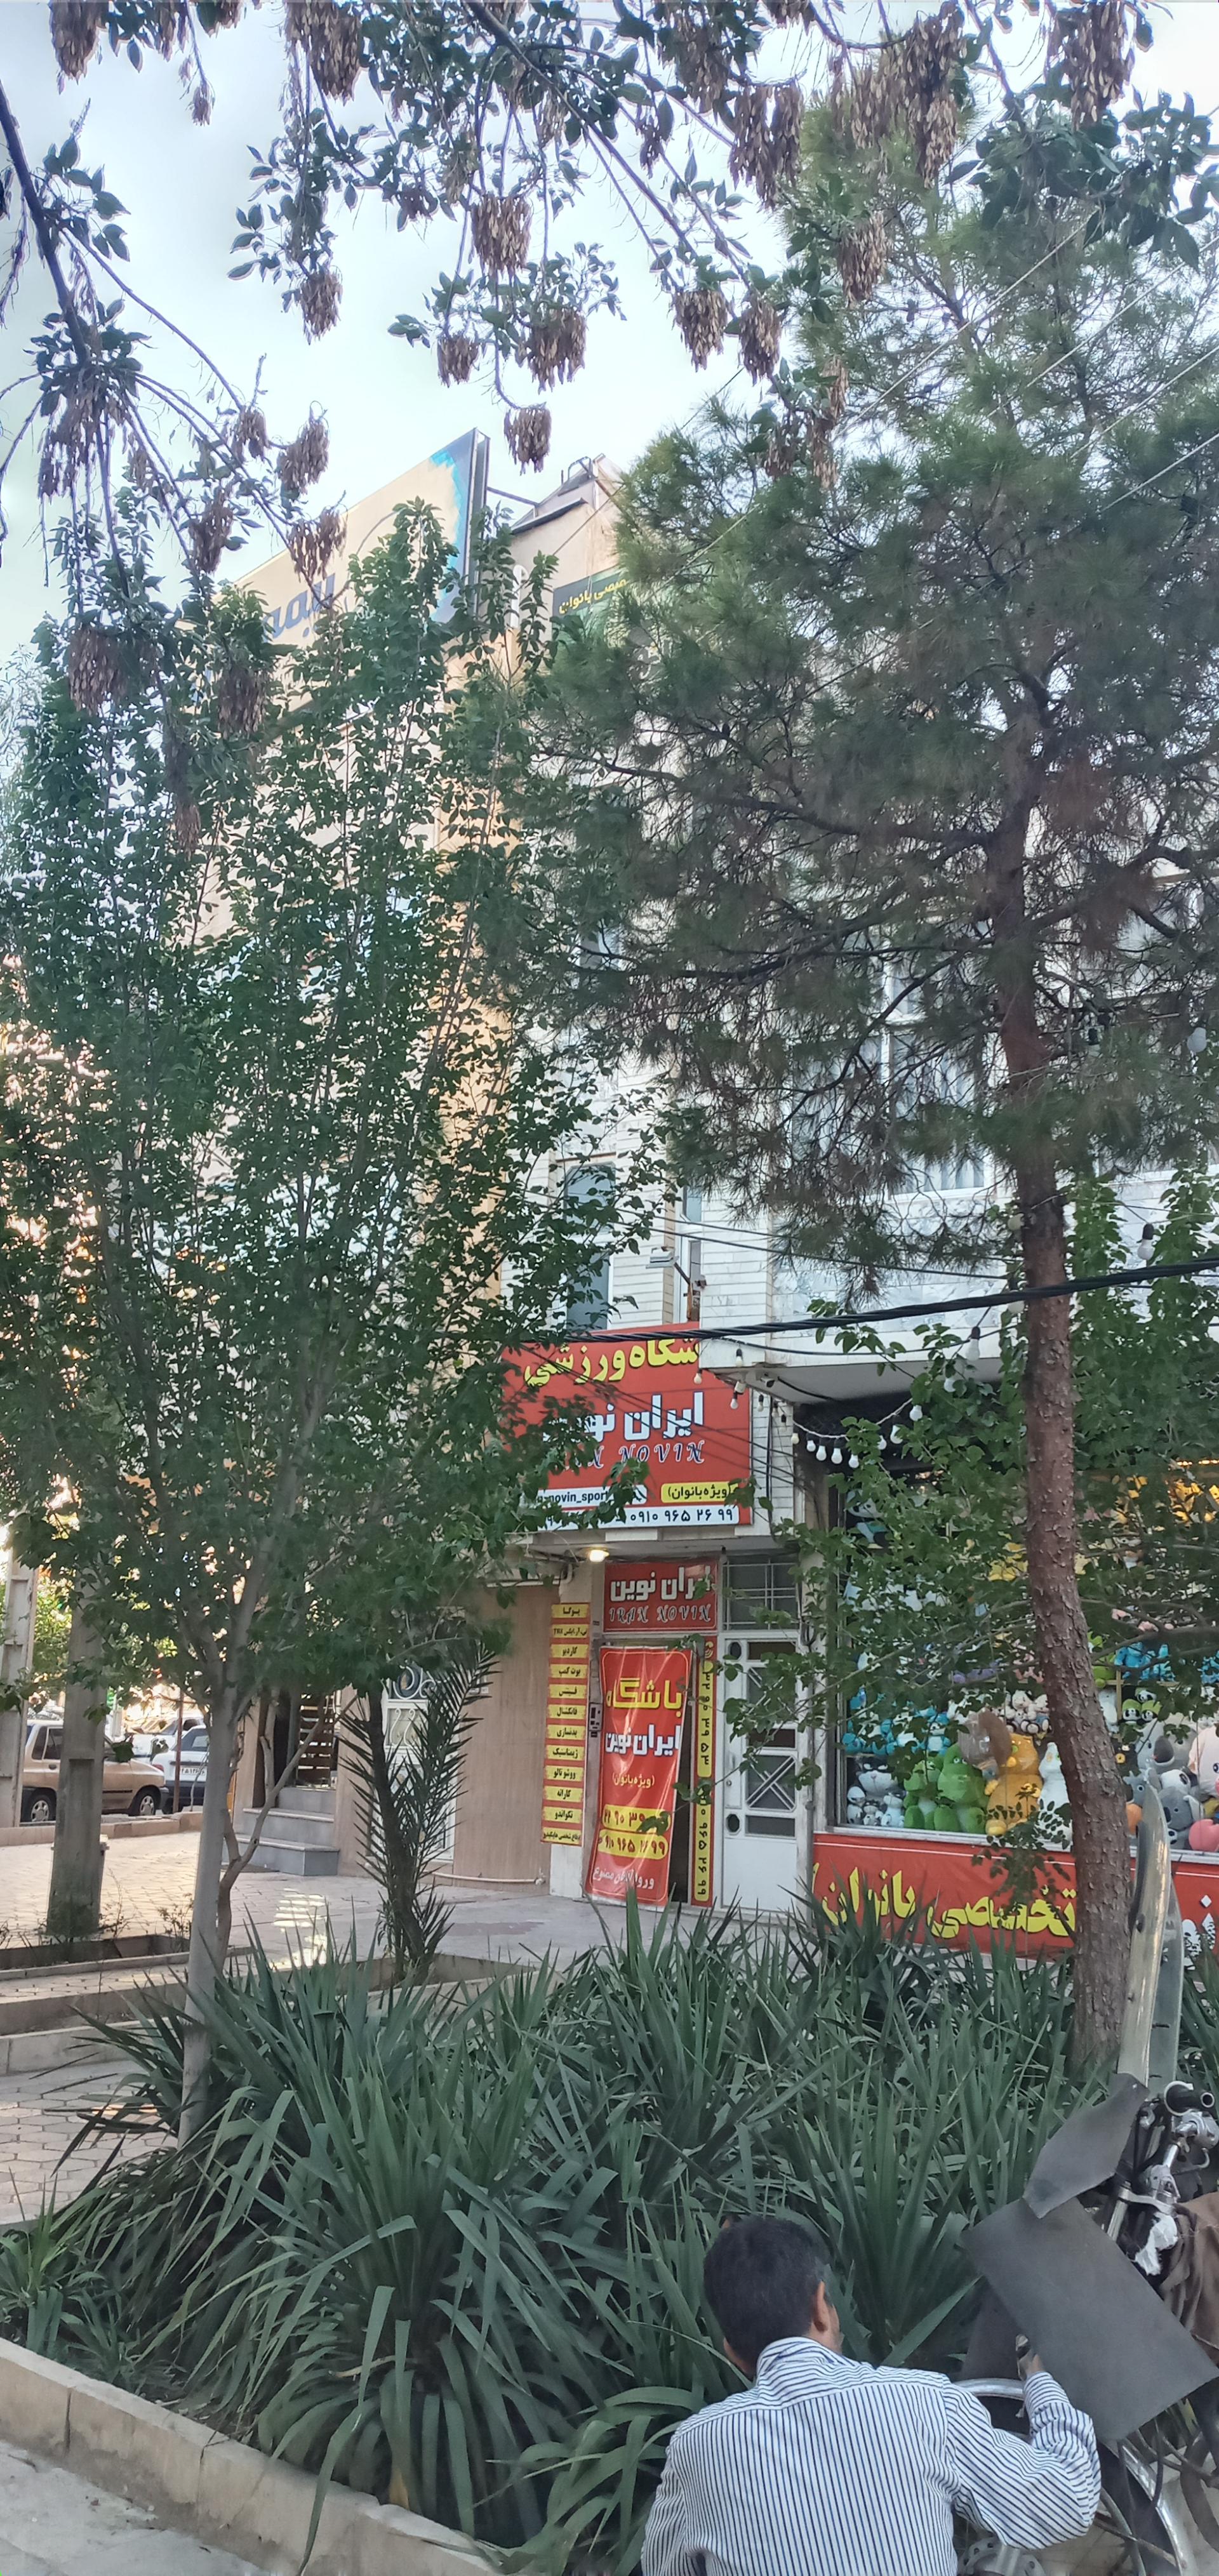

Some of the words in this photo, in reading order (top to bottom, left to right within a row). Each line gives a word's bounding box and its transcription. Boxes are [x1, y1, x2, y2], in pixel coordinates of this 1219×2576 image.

[559, 589, 593, 614] بانوان
[524, 1344, 625, 1386] ورزشی
[623, 1391, 704, 1441] ایران
[618, 1440, 705, 1464] NOVIN
[630, 1510, 658, 1524] ۰۹۱۰
[664, 1509, 691, 1524] ۹۶۵
[696, 1508, 712, 1522] ۲۶
[718, 1508, 733, 1522] ۹۹
[610, 1572, 656, 1602] نوین
[661, 1565, 711, 1600] اران
[609, 1605, 649, 1625] IRAN
[656, 1603, 712, 1623] NOVIN
[606, 1678, 682, 1718] باشگاه
[605, 1726, 632, 1755] نوین
[633, 1723, 681, 1756] ایران
[651, 1840, 665, 1856] ۹۹
[698, 1822, 708, 1850] ۹۶۵
[698, 1857, 707, 1873] ۲۶
[697, 1880, 707, 1895] ۹۹
